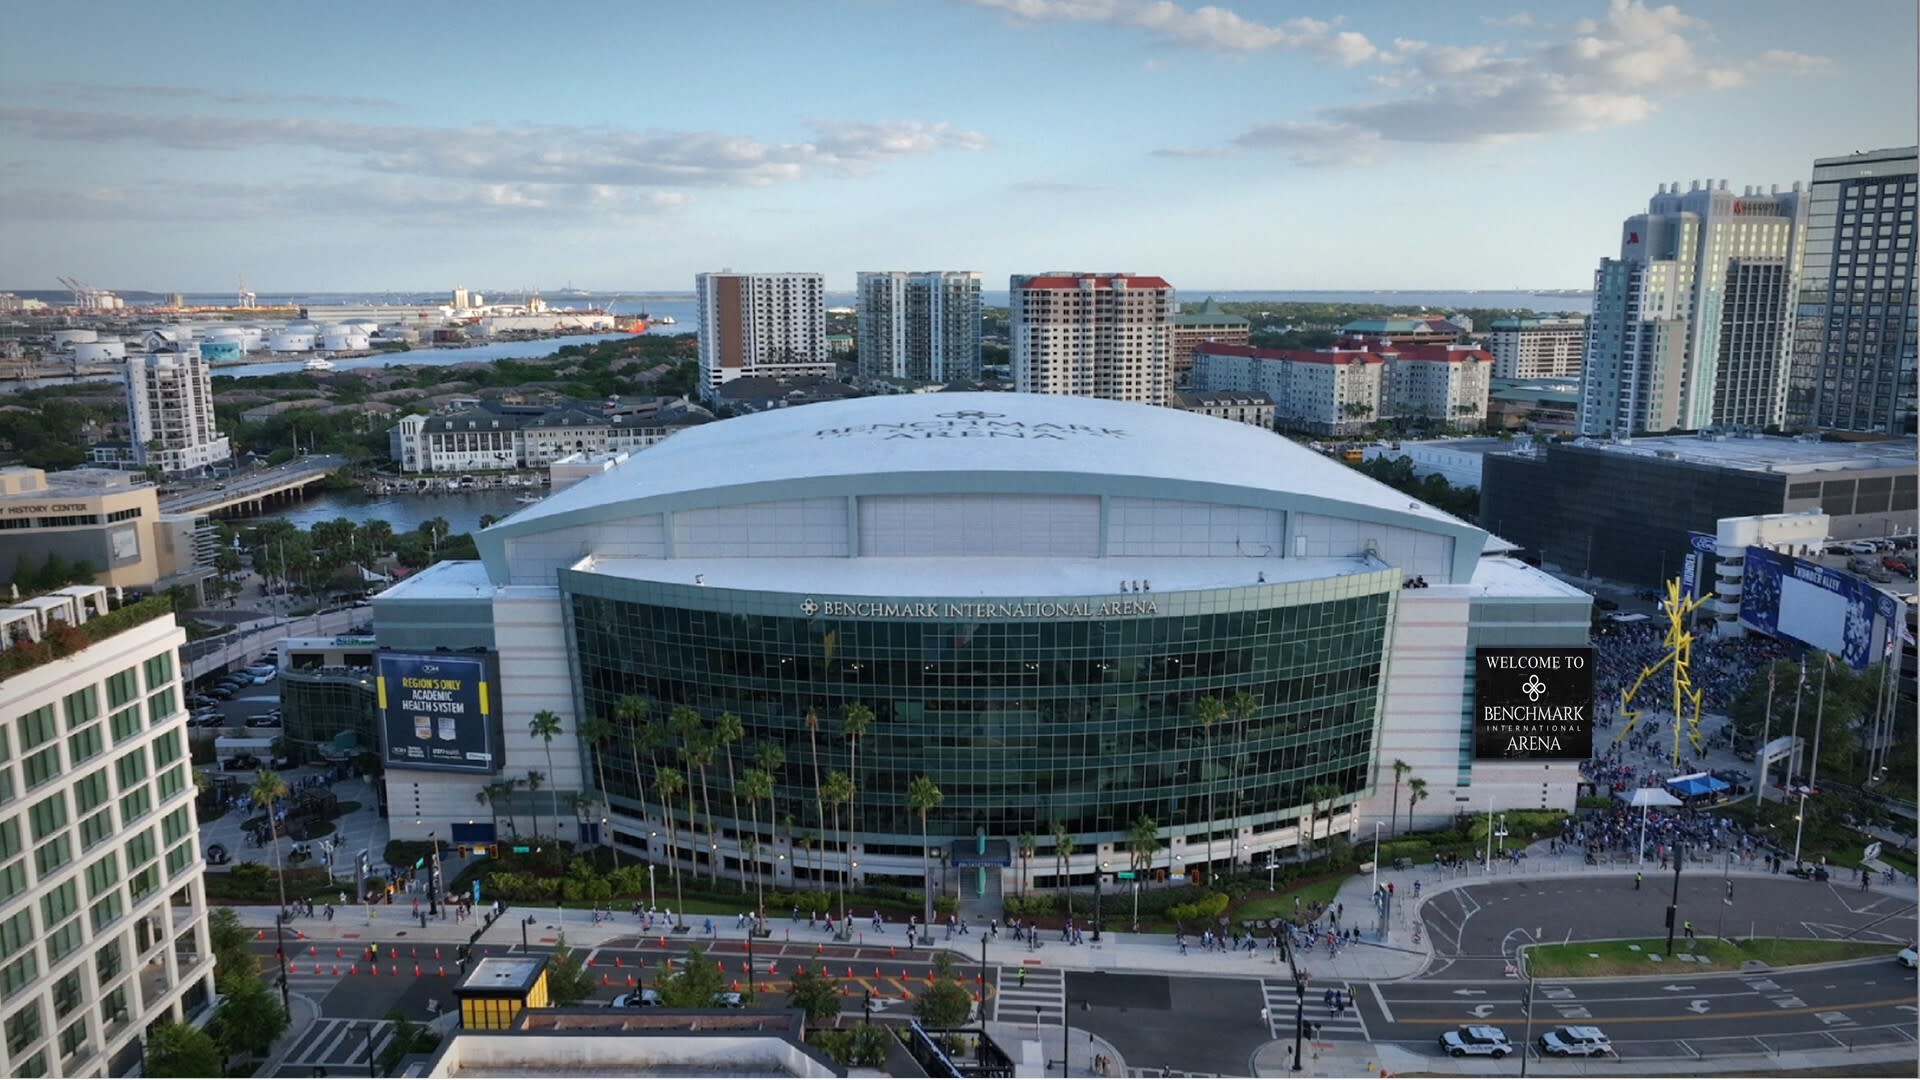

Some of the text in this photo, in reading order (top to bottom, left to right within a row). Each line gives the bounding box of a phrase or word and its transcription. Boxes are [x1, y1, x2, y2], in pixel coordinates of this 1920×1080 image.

[884, 431, 1065, 441] ARENA
[8, 504, 48, 514] HISTORY
[51, 503, 88, 512] CENTER
[1683, 553, 1696, 587] THUNDER
[1793, 565, 1841, 591] THUNDER ALLEY
[824, 600, 1159, 617] BENCHMARK INTERNATIONAL ARENA
[1486, 656, 1584, 669] WELCOME TO
[440, 680, 461, 691] ONLY
[412, 689, 453, 701] ACADEMIC
[402, 700, 465, 714] HEALTH SYSTEM
[1484, 706, 1584, 721] BENCHMARK
[1507, 736, 1561, 751] ARENA
